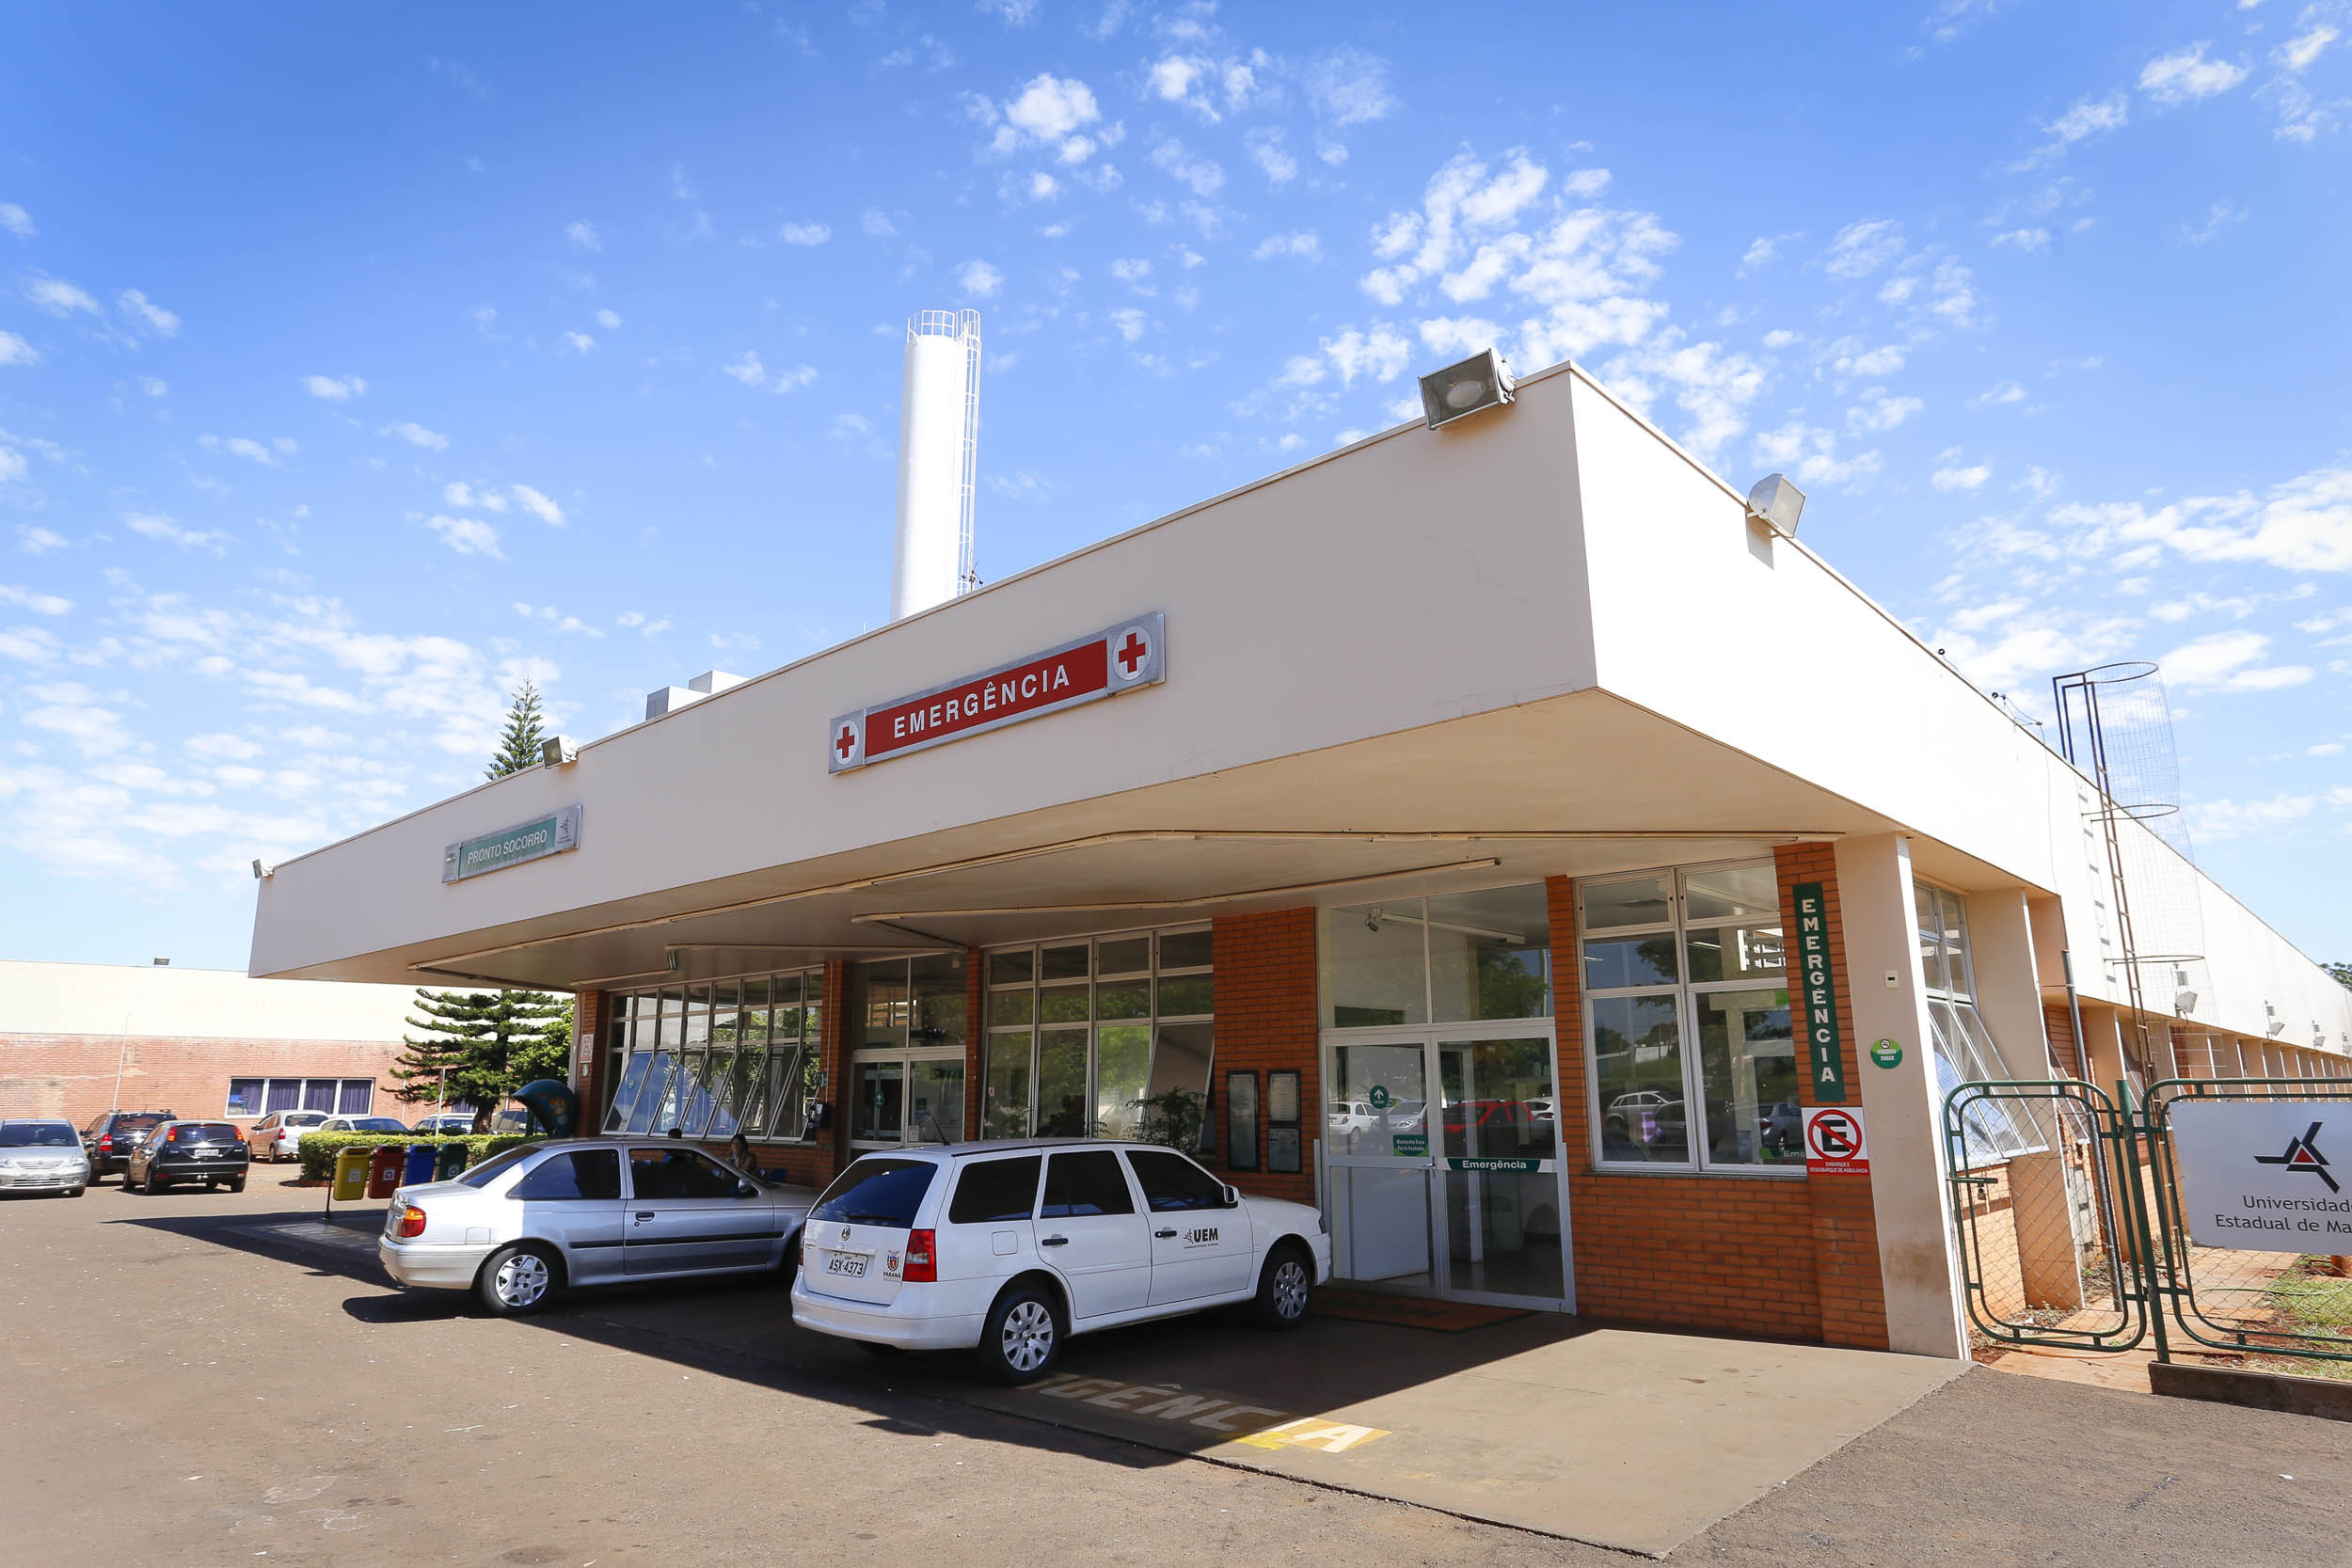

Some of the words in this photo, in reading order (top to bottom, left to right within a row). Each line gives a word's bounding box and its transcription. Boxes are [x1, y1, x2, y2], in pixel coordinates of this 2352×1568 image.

[894, 664, 1070, 738] EMERGÊNCIA
[468, 844, 501, 864] PRONTO
[502, 829, 548, 855] SOCORRO
[1802, 898, 1836, 1082] EMERGÊNCIA
[1462, 1160, 1527, 1170] Emergência
[1194, 1227, 1218, 1243] UEM
[2216, 1214, 2291, 1230] Estadual
[2297, 1218, 2320, 1232] de
